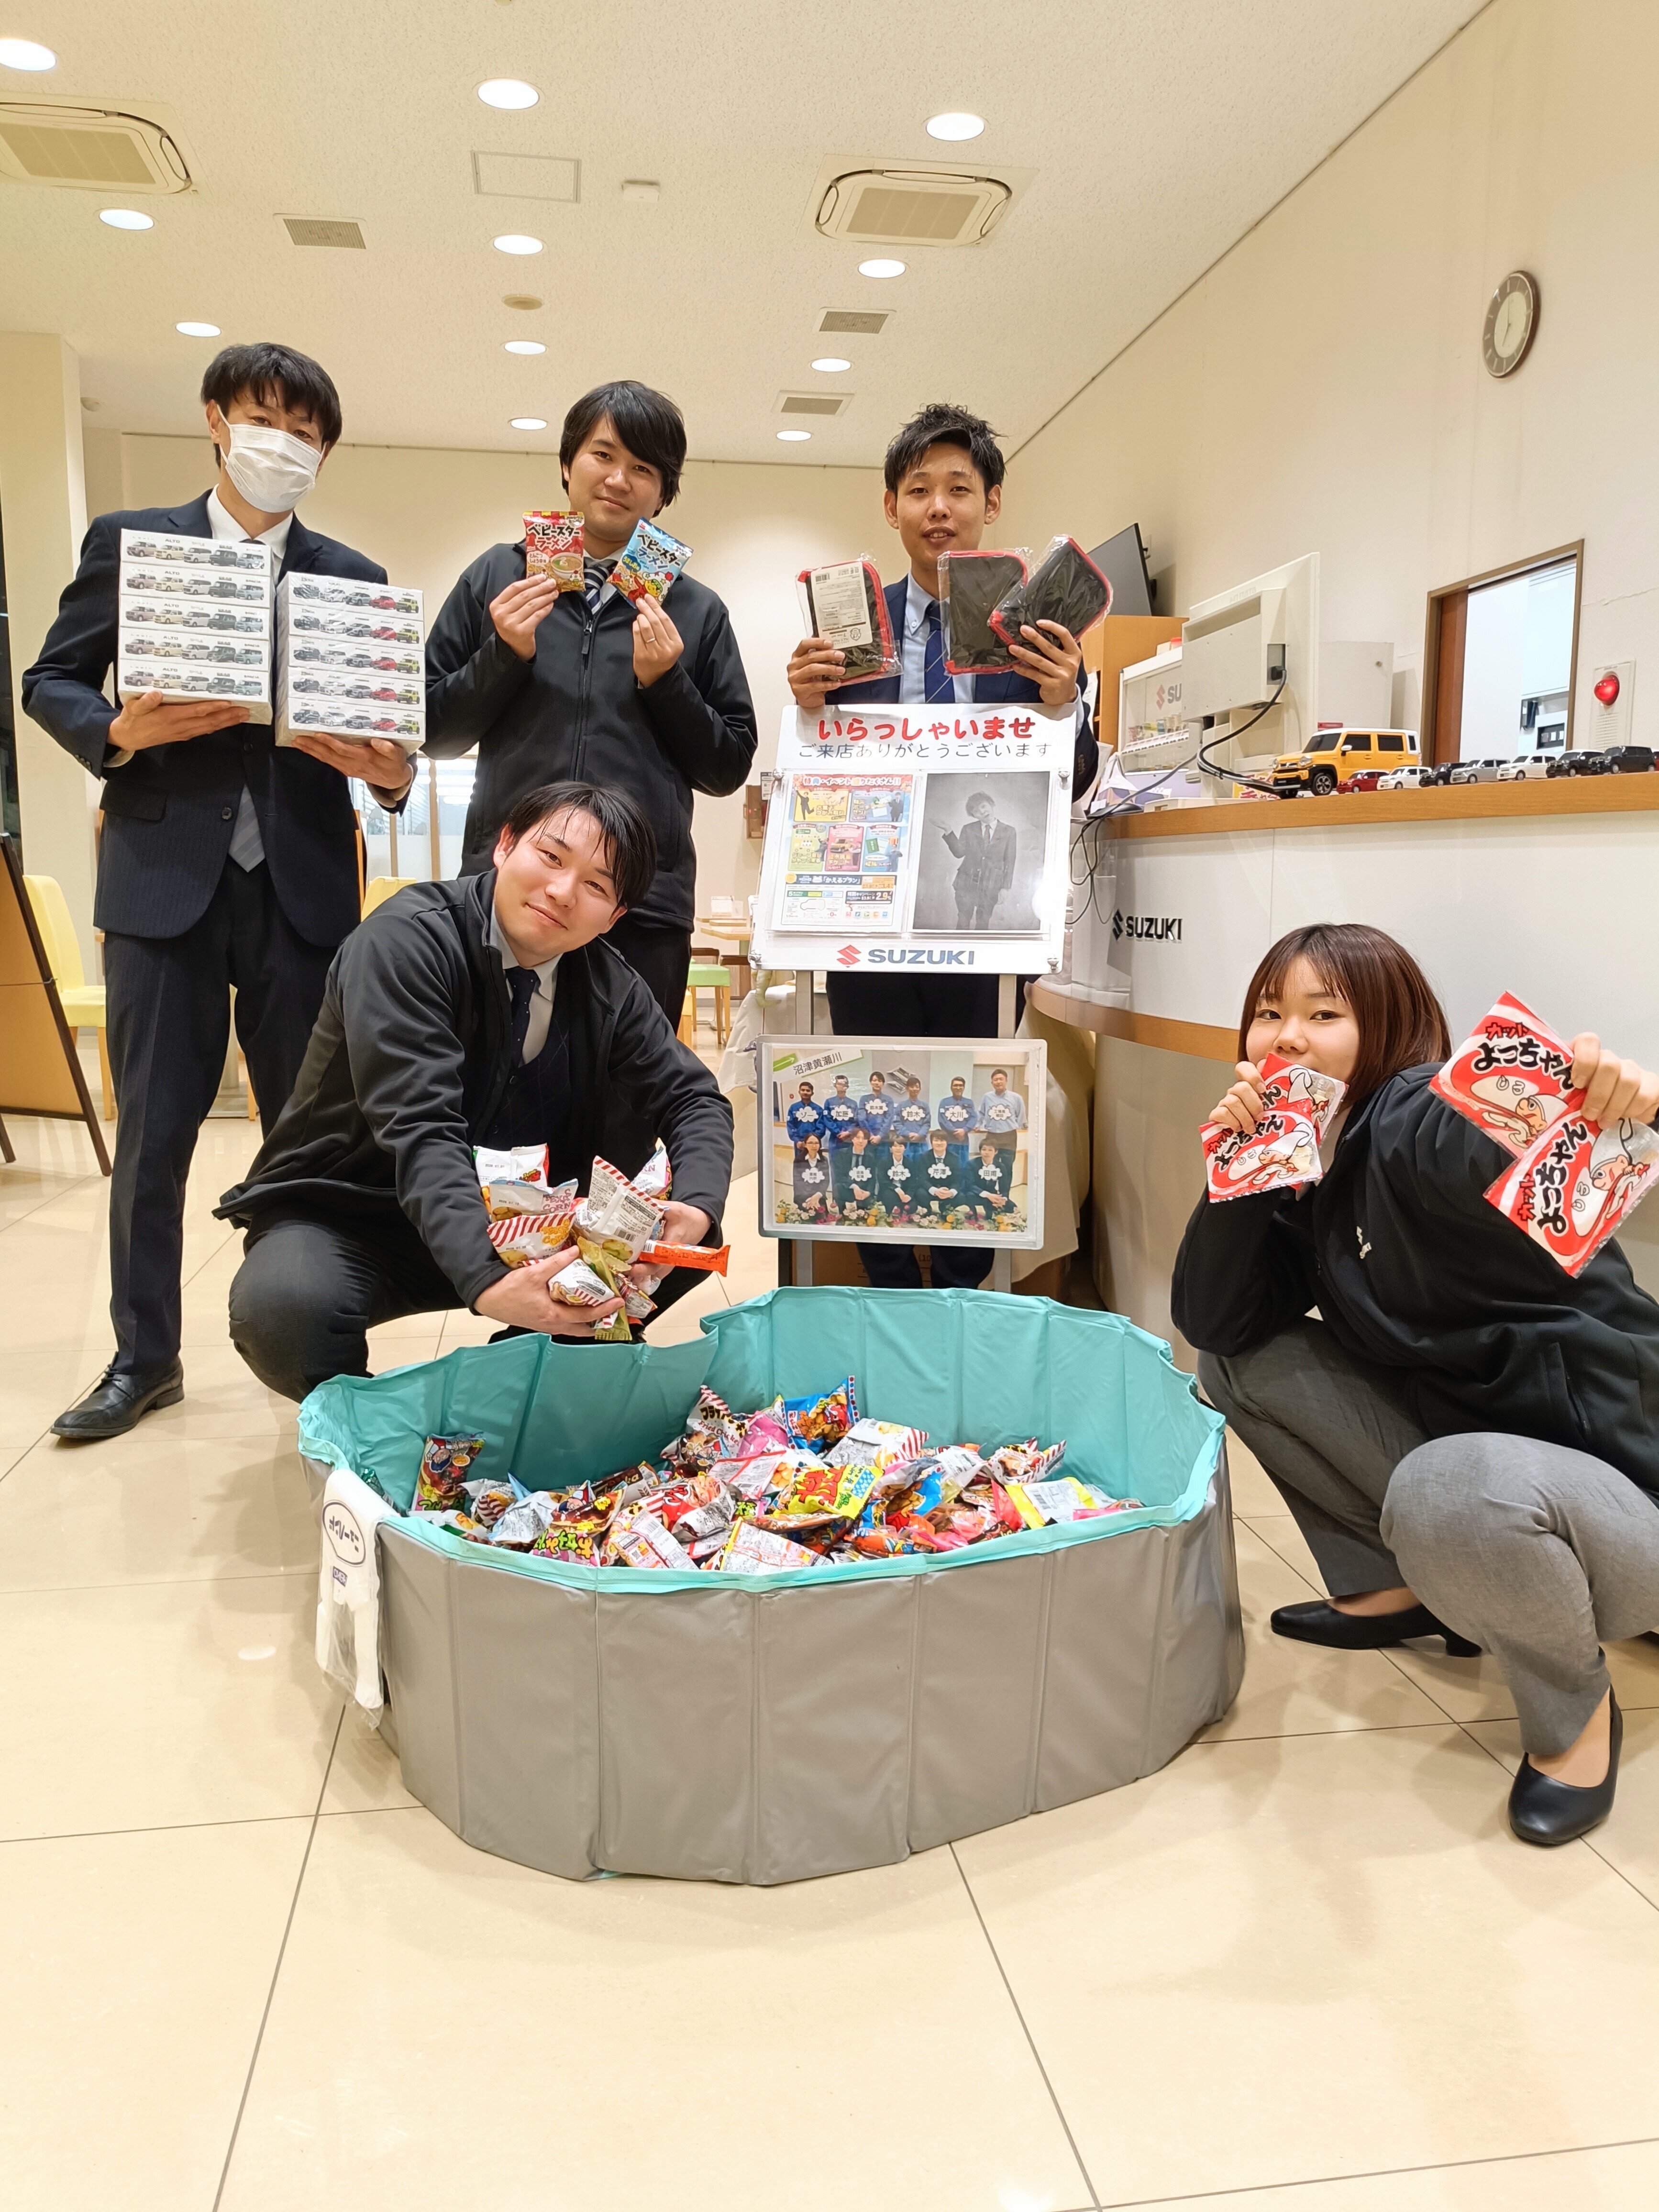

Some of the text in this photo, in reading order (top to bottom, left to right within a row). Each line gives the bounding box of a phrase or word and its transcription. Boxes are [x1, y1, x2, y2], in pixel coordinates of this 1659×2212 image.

[528, 524, 580, 537] ベビースター
[537, 537, 571, 548] ラーメン
[637, 534, 680, 566] ベビースター
[639, 546, 668, 569] ラーメン
[818, 717, 1035, 741] いらっしゃいませ
[799, 742, 1052, 758] ご来店ありがとうございます
[1126, 916, 1183, 940] SUZUKI
[867, 949, 974, 965] SUZUKI
[1485, 1022, 1531, 1041] カット
[793, 1052, 842, 1075] 沼津黄瀬川
[1473, 1038, 1575, 1090] よっちゃん
[1207, 1128, 1234, 1154] カット
[1214, 1115, 1283, 1171] よっちゃん
[1536, 1122, 1588, 1234] よっちゃん
[543, 1202, 571, 1214] CORN
[1517, 1173, 1537, 1221] カット
